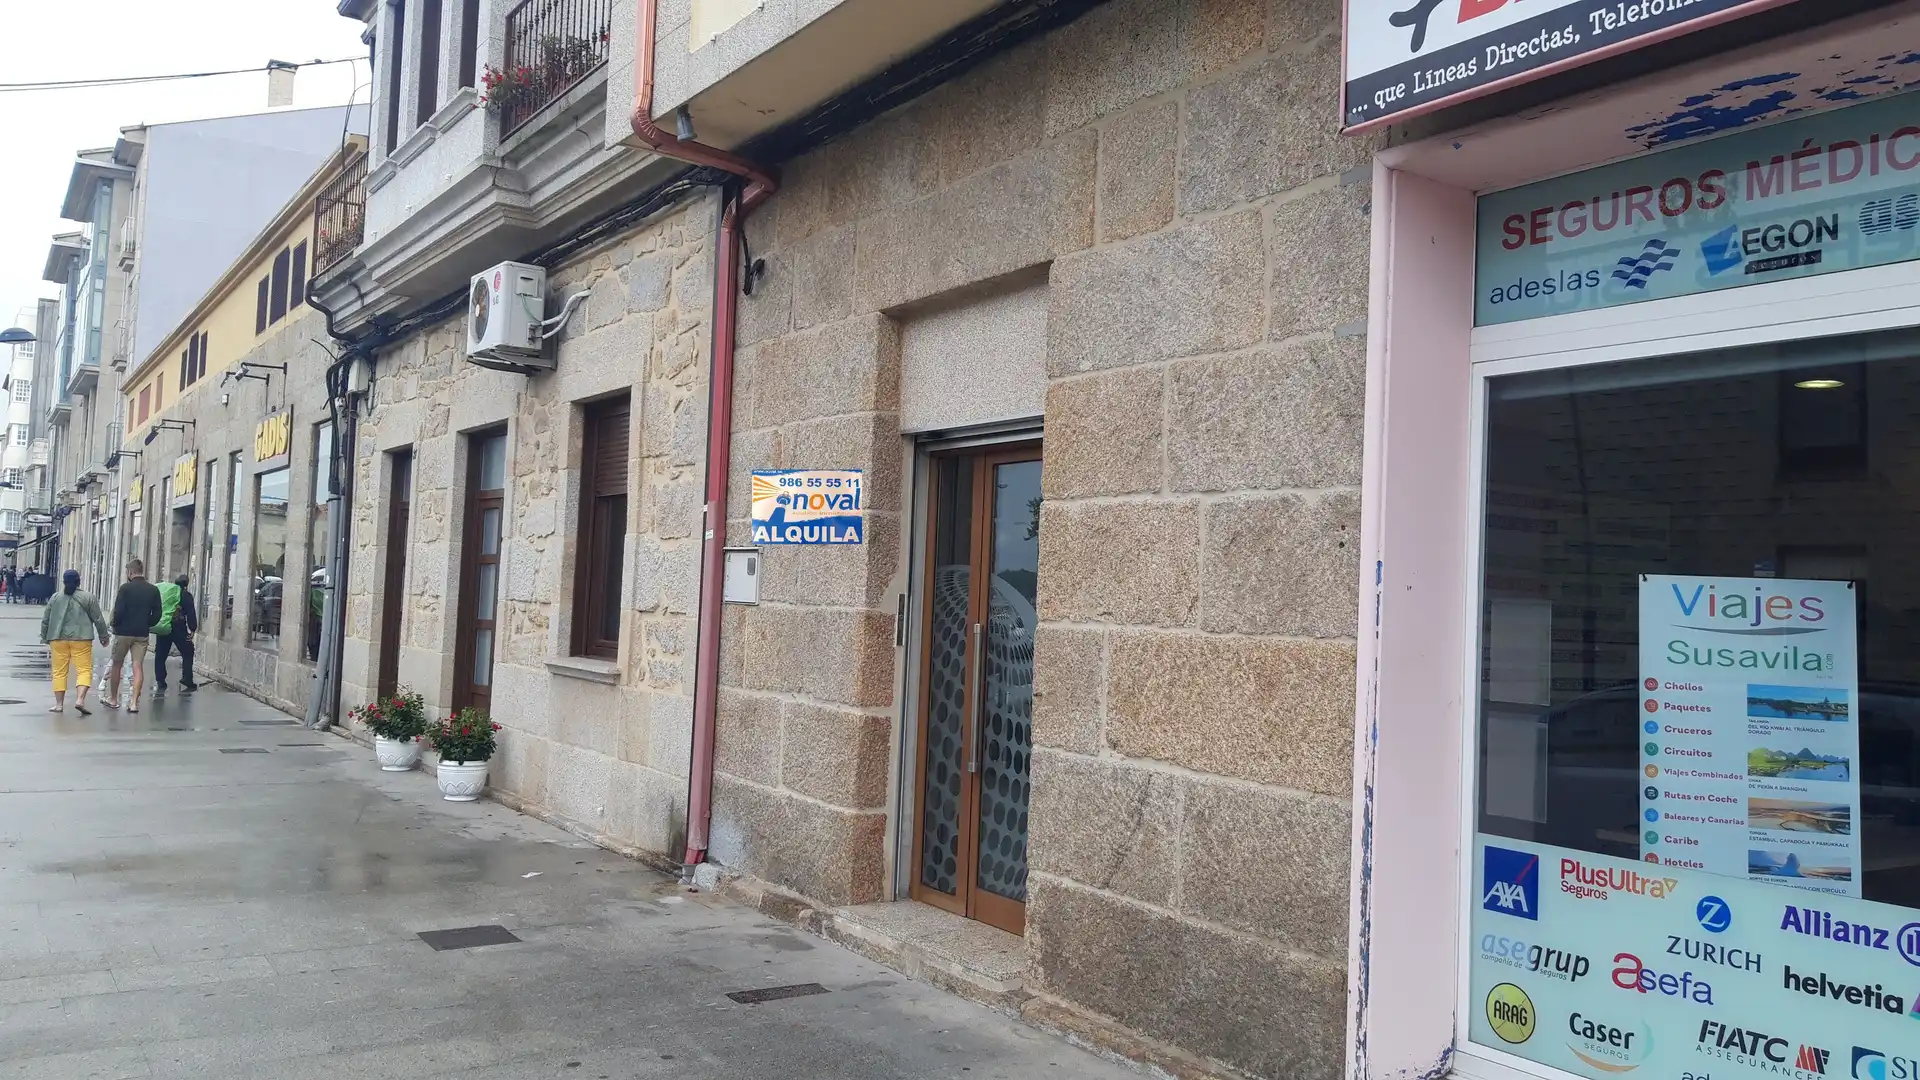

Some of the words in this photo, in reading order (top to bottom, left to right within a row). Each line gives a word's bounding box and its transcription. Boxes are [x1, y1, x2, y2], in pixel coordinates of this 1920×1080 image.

[1374, 81, 1406, 108] que
[1485, 24, 1581, 71] Directas,
[1501, 169, 1727, 250] SEGUROS
[1490, 269, 1601, 304] adeslas
[255, 412, 290, 462] GADIS
[174, 456, 197, 498] GADIS
[779, 477, 803, 487] 986
[806, 478, 822, 487] 55
[826, 478, 842, 487] 55
[845, 478, 860, 487] 11
[752, 525, 860, 543] ALQUILA
[1671, 583, 1825, 626] Viajes
[1666, 640, 1822, 671] Susavila
[1664, 682, 1703, 691] Chollos
[1664, 702, 1712, 713] Paquetes
[1664, 725, 1712, 735] Cruceros
[1664, 747, 1712, 757] Circuitos
[1664, 768, 1689, 777] Viajes
[1691, 770, 1743, 780] Combinados
[1664, 791, 1691, 800] Rutas
[1708, 794, 1738, 804] Coche
[1664, 813, 1699, 822] Baleares
[1707, 817, 1745, 825] Canarias
[1664, 835, 1699, 845] Caribe
[1664, 858, 1704, 868] Hoteles
[1560, 858, 1666, 900] PlusUltra
[1561, 880, 1608, 900] Seguros
[1483, 880, 1529, 913] AXA
[1780, 905, 1890, 950] Allianz
[1481, 933, 1590, 982] asegrup
[1514, 960, 1523, 968] de
[1666, 935, 1762, 973] ZURICH
[1539, 968, 1567, 981] seguros
[1612, 952, 1714, 1005] asefa
[1784, 964, 1904, 1015] helvetia
[1493, 999, 1528, 1027] ARAG
[1569, 1012, 1635, 1050] Caser
[1698, 1019, 1789, 1063] FIATC
[1584, 1042, 1629, 1061] SEGUROS
